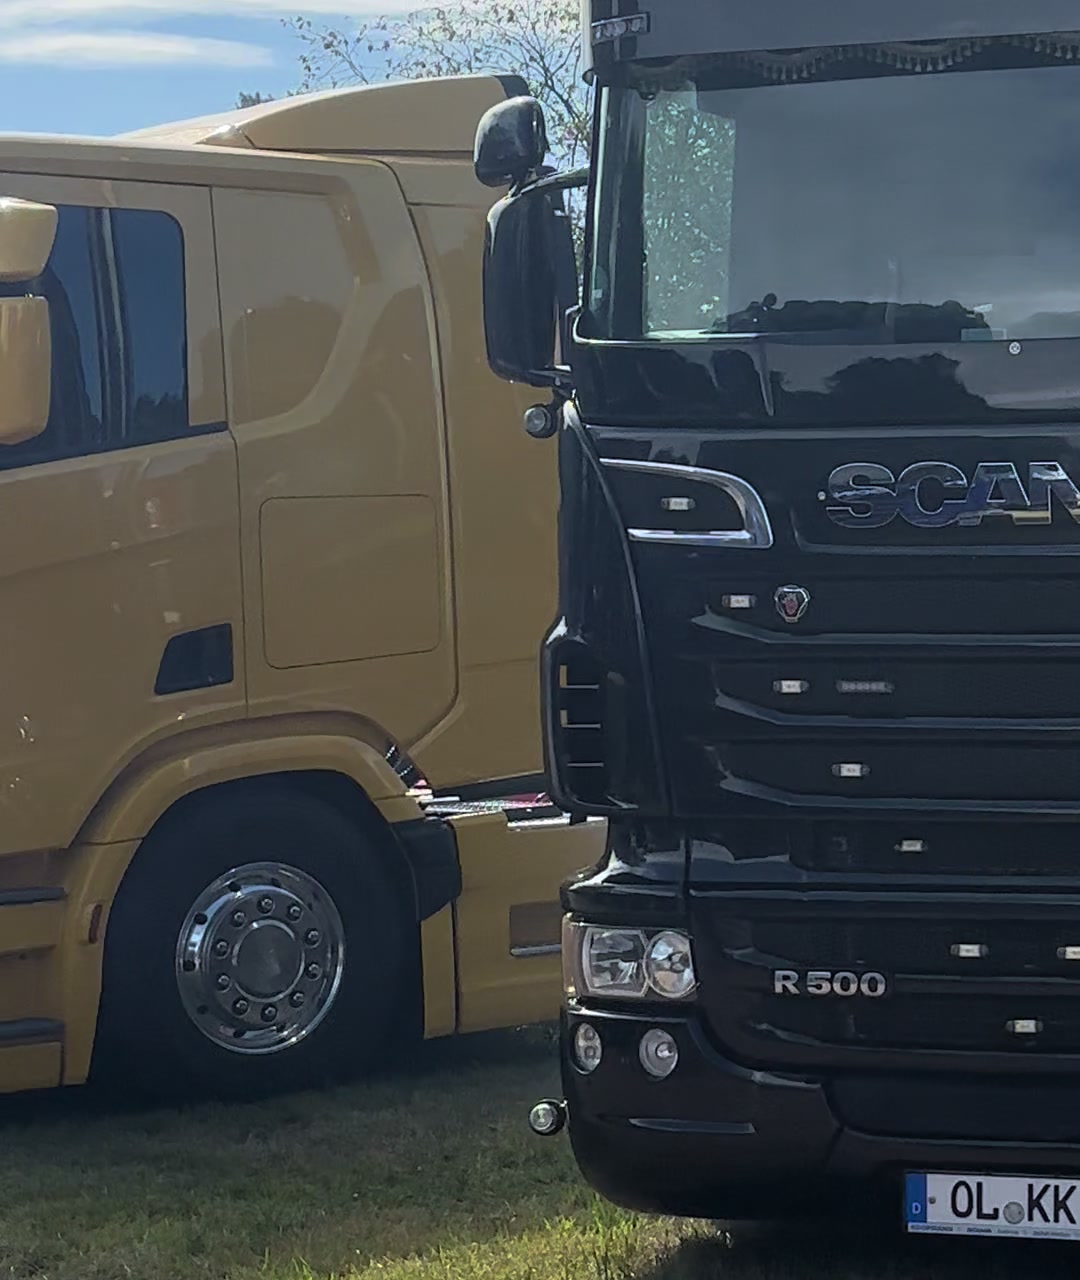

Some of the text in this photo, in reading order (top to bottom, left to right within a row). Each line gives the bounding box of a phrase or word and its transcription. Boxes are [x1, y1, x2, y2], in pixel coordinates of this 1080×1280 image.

[774, 970, 886, 997] R 500
[912, 1201, 921, 1215] D
[950, 1180, 1000, 1220] OL
[1027, 1183, 1078, 1225] KK
